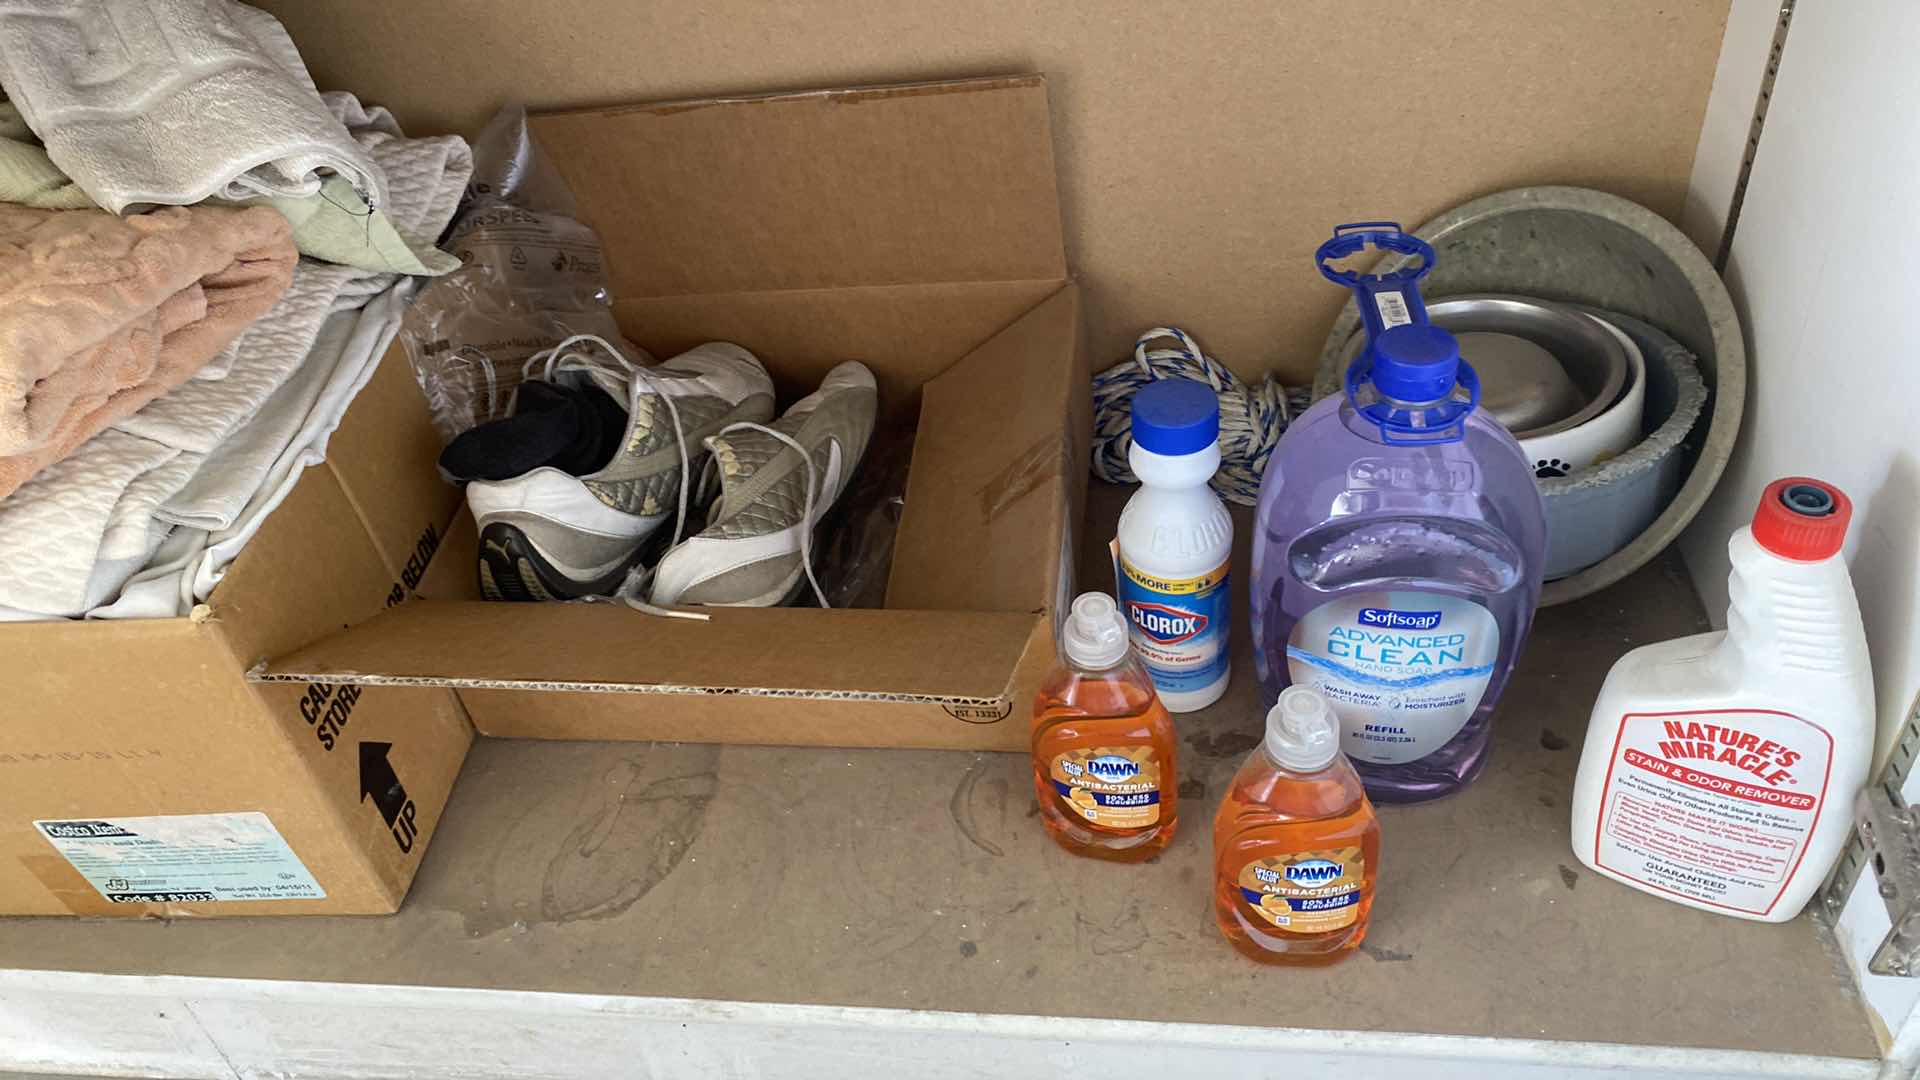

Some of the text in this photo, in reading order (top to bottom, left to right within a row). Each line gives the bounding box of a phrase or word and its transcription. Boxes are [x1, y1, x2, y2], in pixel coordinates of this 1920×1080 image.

[401, 522, 440, 591] BELOW
[1136, 575, 1171, 592] MORE
[1131, 605, 1196, 635] CLOROX
[1363, 609, 1438, 629] Softsoap
[1328, 627, 1465, 648] ADVANCED
[1327, 639, 1464, 665] CLEAN
[1355, 662, 1433, 674] HAND SOAP
[1324, 685, 1381, 700] WASH AWAY
[1405, 698, 1465, 710] MOISTURIZER
[317, 684, 361, 751] STORE
[1365, 724, 1407, 734] REFILL
[1663, 721, 1801, 767] NATURE'S
[1087, 760, 1139, 776] DAWN
[1658, 741, 1792, 785] MIRACLE
[1069, 777, 1155, 791] ANTIBACTERIAL
[1627, 752, 1669, 773] STAIN
[1672, 768, 1683, 778] &
[1687, 773, 1731, 791] ODOR
[1734, 787, 1811, 807] REMOVER
[1618, 777, 1635, 787] Even
[1636, 785, 1657, 795] Urine
[1658, 792, 1682, 804] Odors
[1683, 800, 1706, 811] Other
[1708, 808, 1742, 820] Products
[1771, 822, 1804, 831] Remove
[1629, 774, 1676, 795] Permanently
[1677, 791, 1715, 806] Eliminates
[1730, 806, 1754, 815] Stains
[1764, 814, 1789, 822] Odors
[46, 824, 88, 836] Costco
[393, 800, 418, 854] UP
[1616, 842, 1632, 851] Safe
[1648, 854, 1662, 862] Use
[1664, 860, 1692, 871] Around
[1694, 869, 1726, 880] Children
[1254, 866, 1280, 878] SPECIAL
[1285, 864, 1344, 880] DAWN
[1645, 862, 1726, 889] GUARANTEED
[1654, 871, 1673, 880] YOUR
[1675, 878, 1701, 888] MONEY
[112, 893, 151, 902] Code
[1263, 882, 1356, 897] ANTIBACTERIAL
[1302, 901, 1349, 910] SCRUBBING
[1326, 895, 1349, 903] LESS
